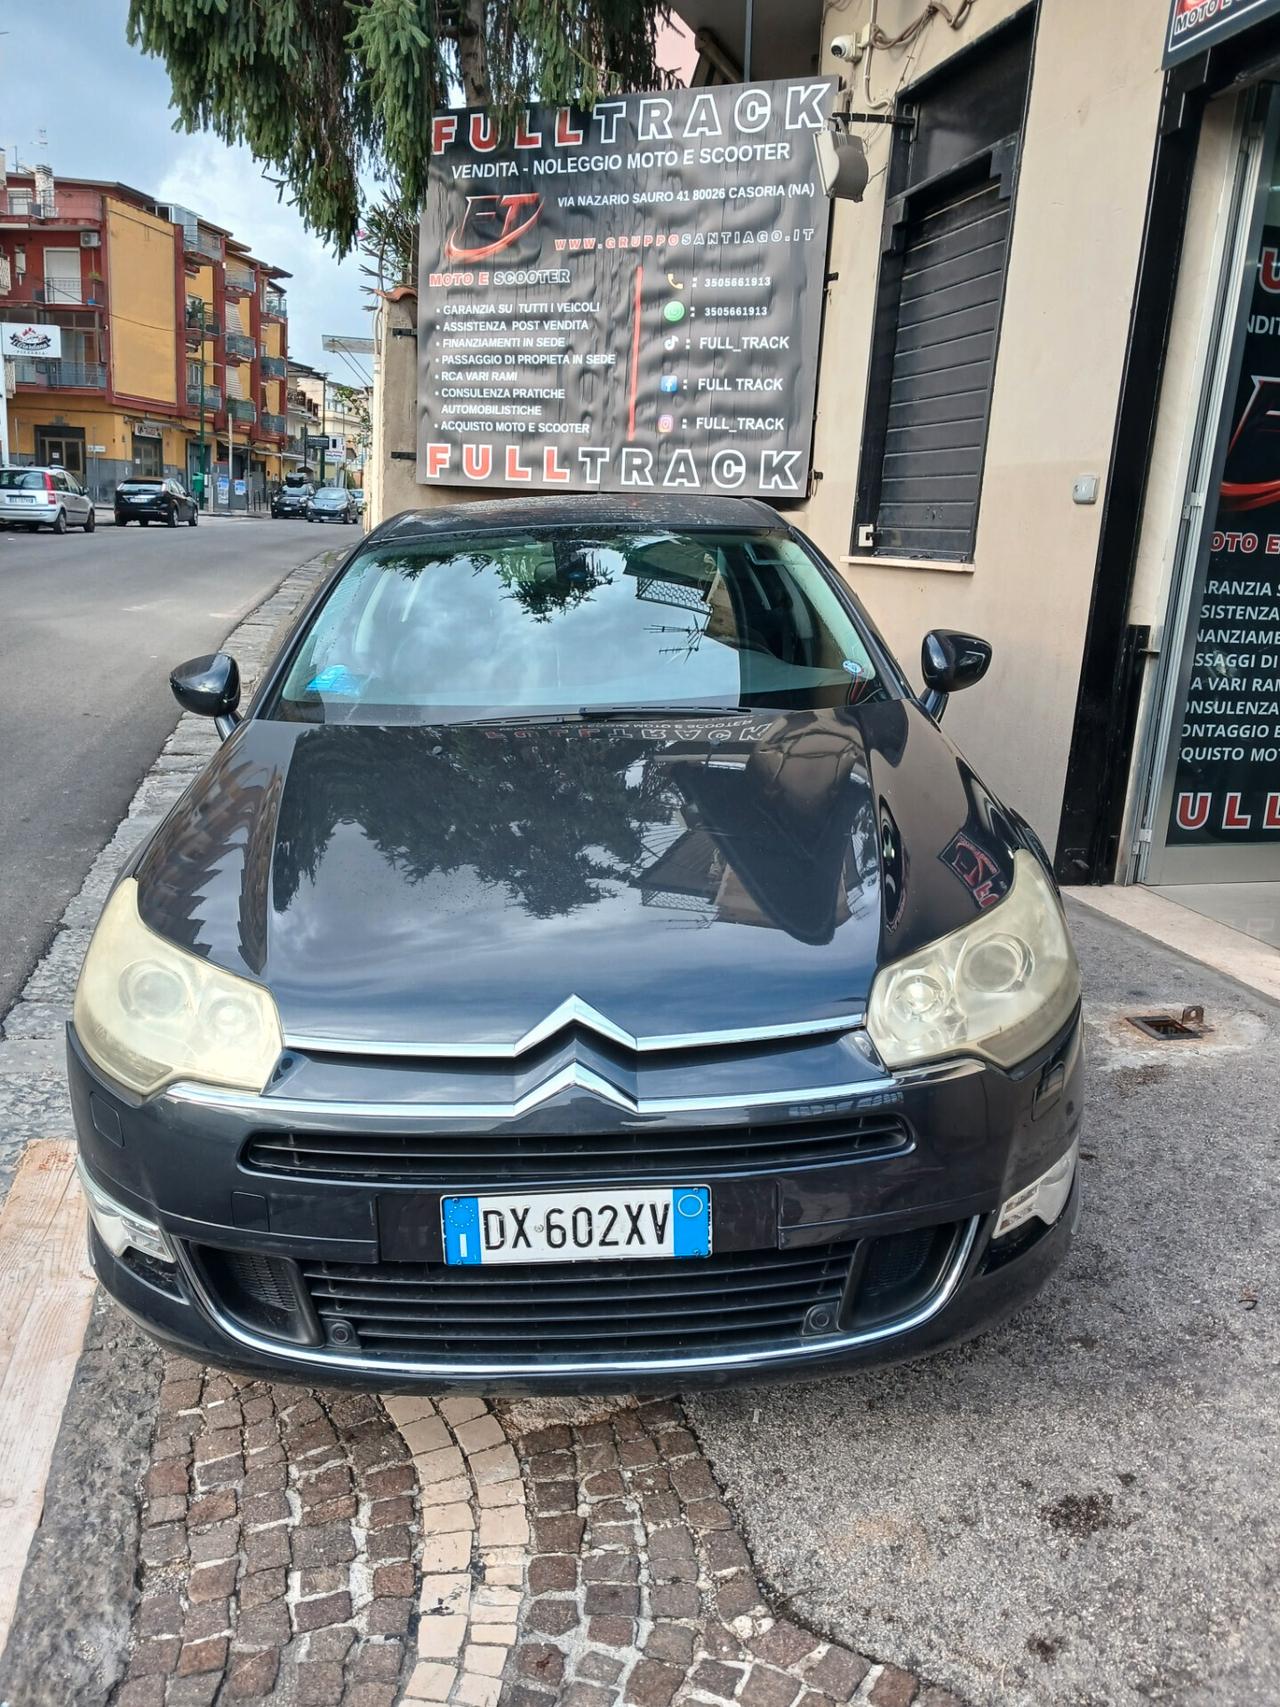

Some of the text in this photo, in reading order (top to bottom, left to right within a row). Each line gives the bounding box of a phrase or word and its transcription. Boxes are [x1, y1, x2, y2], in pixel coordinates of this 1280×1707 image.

[1174, 0, 1219, 36] MOTO
[452, 162, 519, 179] VENDITA
[533, 155, 622, 176] NOLEGGIO
[627, 150, 678, 169] MOTO
[683, 149, 694, 165] E
[699, 142, 790, 164] SCOOTER
[558, 182, 815, 208] VIA NAZARIO SAURO 41 80026 CASORIA (NA)
[554, 228, 815, 251] WWW.GRUPPOSANTIAGO.IT
[429, 269, 571, 287] MOTO E SCOOTER
[704, 277, 771, 287] 3505661913
[443, 303, 496, 315] GARANZIA
[497, 303, 513, 314] SU
[519, 303, 548, 313] TUTTI
[556, 302, 600, 313] VEICOLI
[704, 307, 768, 316] 3505661913
[443, 320, 589, 332] ASSISTENZA POST VENDITA
[443, 337, 566, 348] FINANZIAMENTI IN SEDE
[700, 336, 790, 352] FULL_TRACK
[441, 354, 616, 365] PASSAGGIO DI PROPIETA IN SEDE
[442, 371, 518, 381] RCA VARI RAMI
[698, 378, 732, 391] FULL
[736, 378, 784, 391] TRACK
[442, 388, 565, 399] CONSULENZA PRATICHE
[441, 405, 542, 416] AUTOMOBILISTICHE
[441, 421, 590, 434] ACQUISTO MOTO E SCOOTER
[696, 417, 784, 433] FULL_TRACK
[1193, 653, 1278, 669] SSAGGI DI
[1208, 677, 1247, 691] VARI
[1185, 700, 1279, 715] NSULENZA
[1178, 747, 1244, 763] QUISTO
[483, 1207, 532, 1250] DX
[545, 1202, 670, 1249] 602XV
